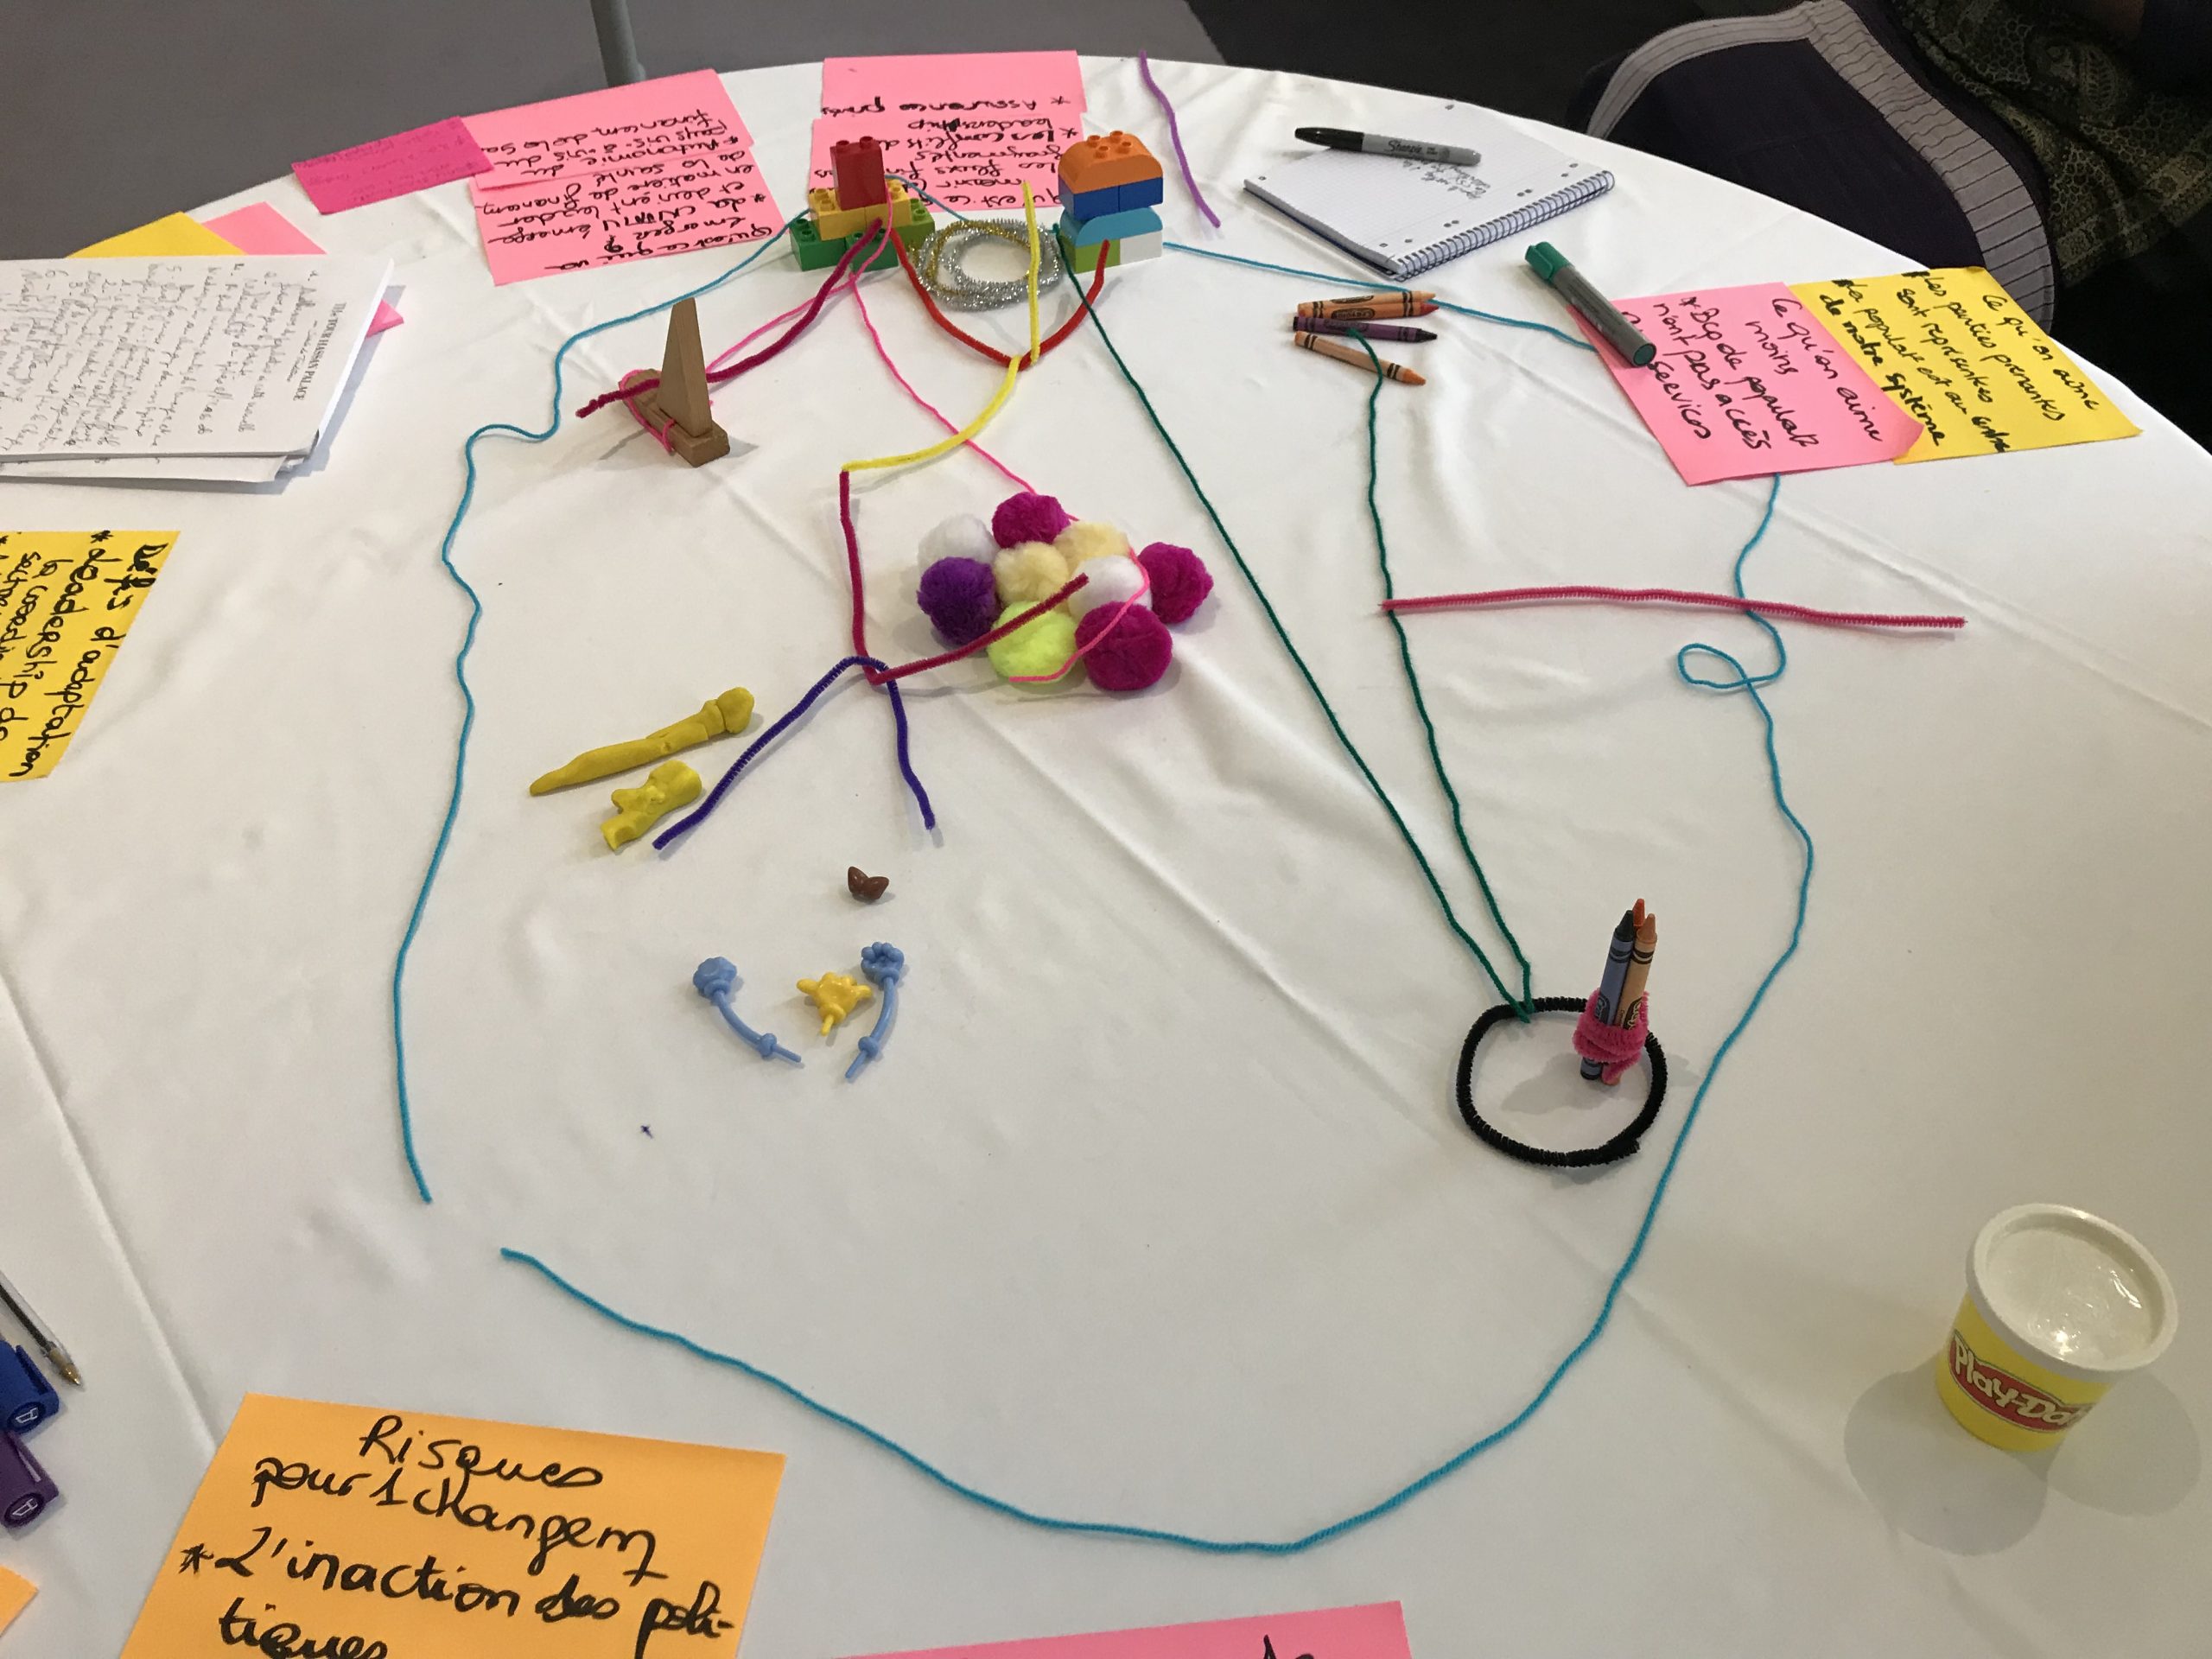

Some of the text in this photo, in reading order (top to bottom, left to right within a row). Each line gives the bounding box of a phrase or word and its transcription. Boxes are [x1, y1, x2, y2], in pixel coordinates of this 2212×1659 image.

[308, 338, 328, 370] HASSAN
[1662, 350, 1721, 391] pas
[293, 370, 315, 401] PALACE
[359, 1414, 603, 1489] Risques
[251, 1456, 372, 1508] pour
[215, 1526, 520, 1617] L'inaction
